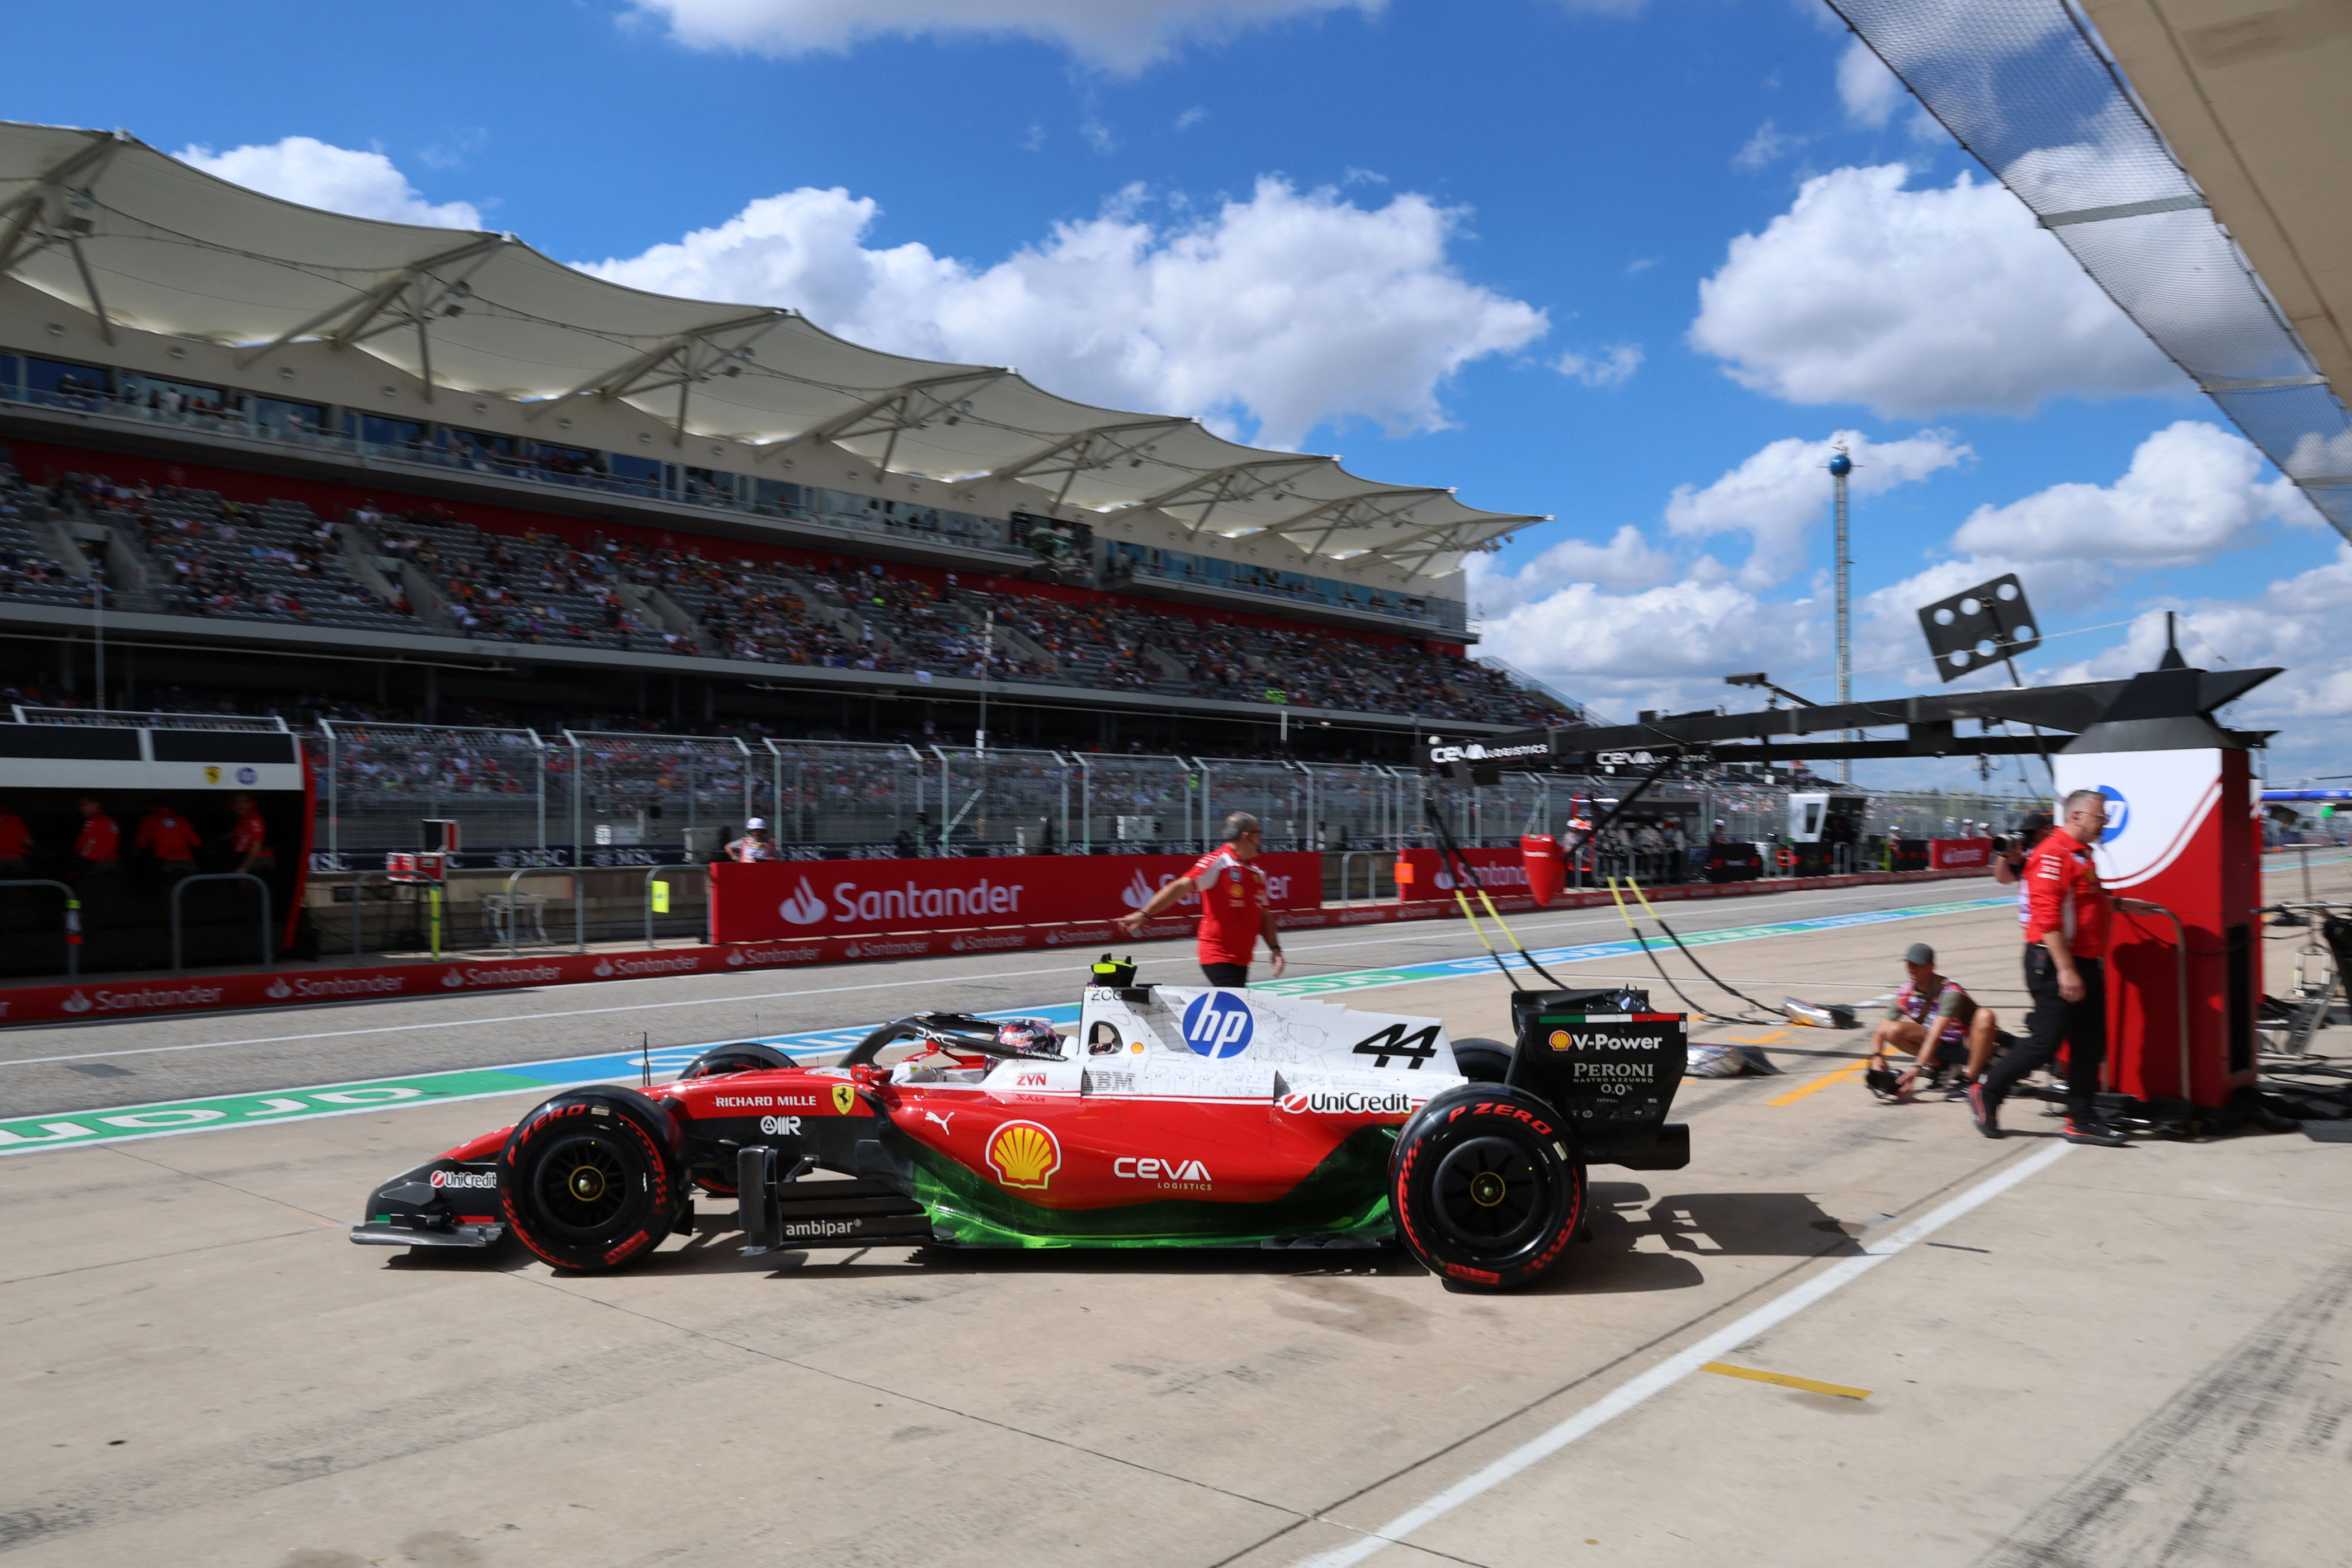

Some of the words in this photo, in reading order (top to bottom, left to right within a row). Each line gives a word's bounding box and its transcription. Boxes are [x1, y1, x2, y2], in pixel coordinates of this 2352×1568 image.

[834, 879, 1024, 923] Santander
[861, 939, 929, 956] Santander
[965, 934, 1027, 950] Santander
[745, 946, 821, 964] Santander
[615, 955, 700, 975] Santander
[466, 965, 562, 986] Santander
[295, 975, 405, 997] Santander
[96, 985, 223, 1010] Santander
[1189, 991, 1248, 1059] hp
[915, 1026, 957, 1046] DXC
[1572, 1034, 1663, 1050] V-Power
[1352, 1023, 1442, 1069] 44
[1574, 1063, 1654, 1076] PERONI
[1017, 1074, 1046, 1086] ZYN
[1084, 1071, 1136, 1091] IBM
[1600, 1083, 1633, 1096] 0.0%
[716, 1096, 773, 1107] RICHARD
[778, 1095, 816, 1106] MILLE
[1311, 1093, 1410, 1112] UniCredit
[519, 1104, 587, 1146] ZERO
[1448, 1106, 1467, 1123] P
[1472, 1103, 1553, 1135] ZERO
[445, 1172, 497, 1188] UniCredit
[1158, 1182, 1212, 1191] LOGISTICS
[786, 1220, 853, 1237] ambipar
